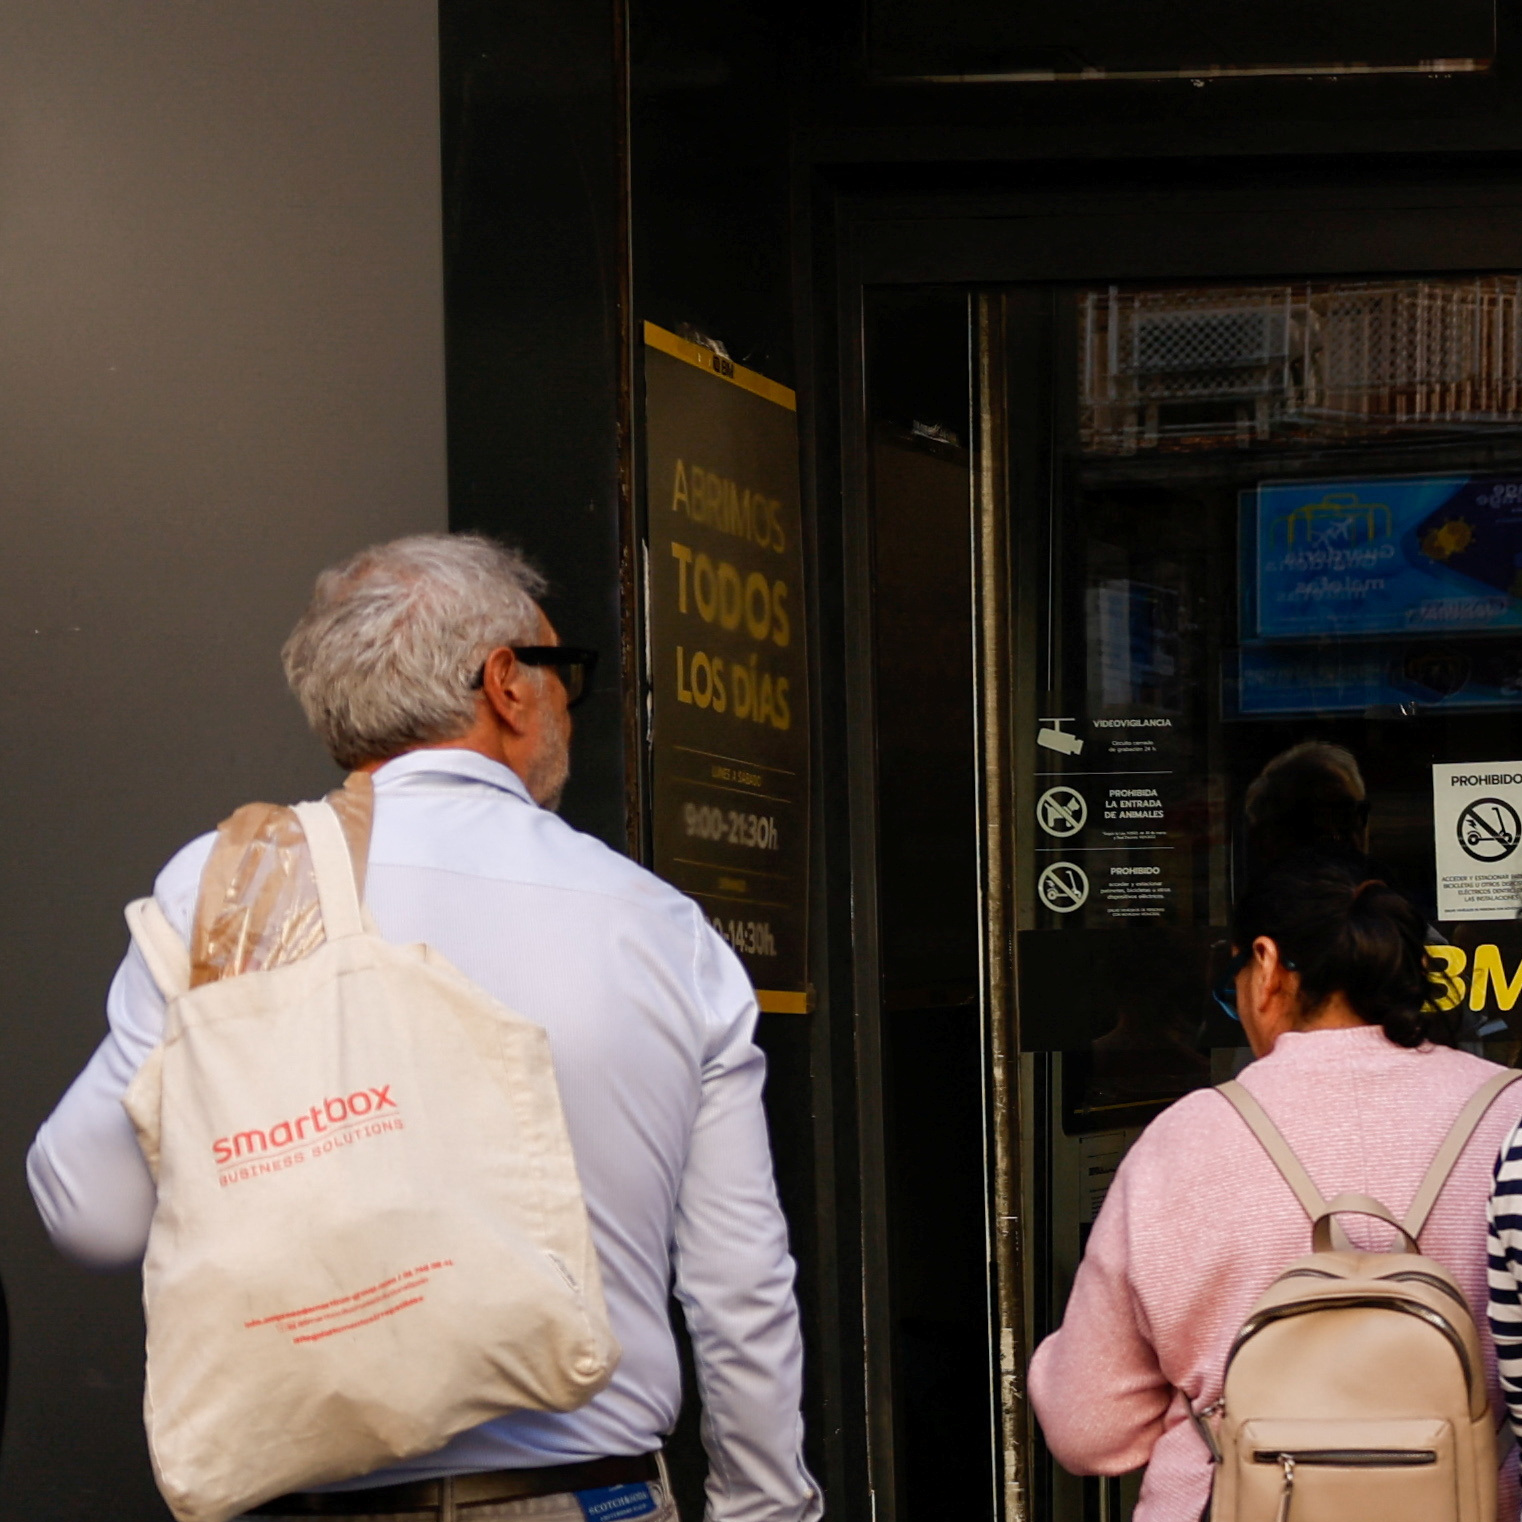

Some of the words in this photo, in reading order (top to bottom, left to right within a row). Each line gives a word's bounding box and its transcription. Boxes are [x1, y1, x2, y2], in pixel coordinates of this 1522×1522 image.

[672, 458, 786, 554] ABRIMOS
[670, 541, 791, 648] TODOS
[676, 645, 727, 714] LOS
[730, 652, 791, 731] DÍAS
[1092, 719, 1173, 728] VIDEOVIGILANCIA
[1105, 800, 1118, 808] LA
[1120, 799, 1163, 808] ENTRADA
[1108, 789, 1159, 798] PROHIBIDA
[1104, 811, 1117, 819] DE
[1119, 810, 1165, 819] ANIMALES
[1110, 866, 1161, 875] PROHIBIDO
[212, 1083, 397, 1165] smartbox
[218, 1152, 305, 1188] BUSINESS
[311, 1118, 405, 1158] SOLUTIONS
